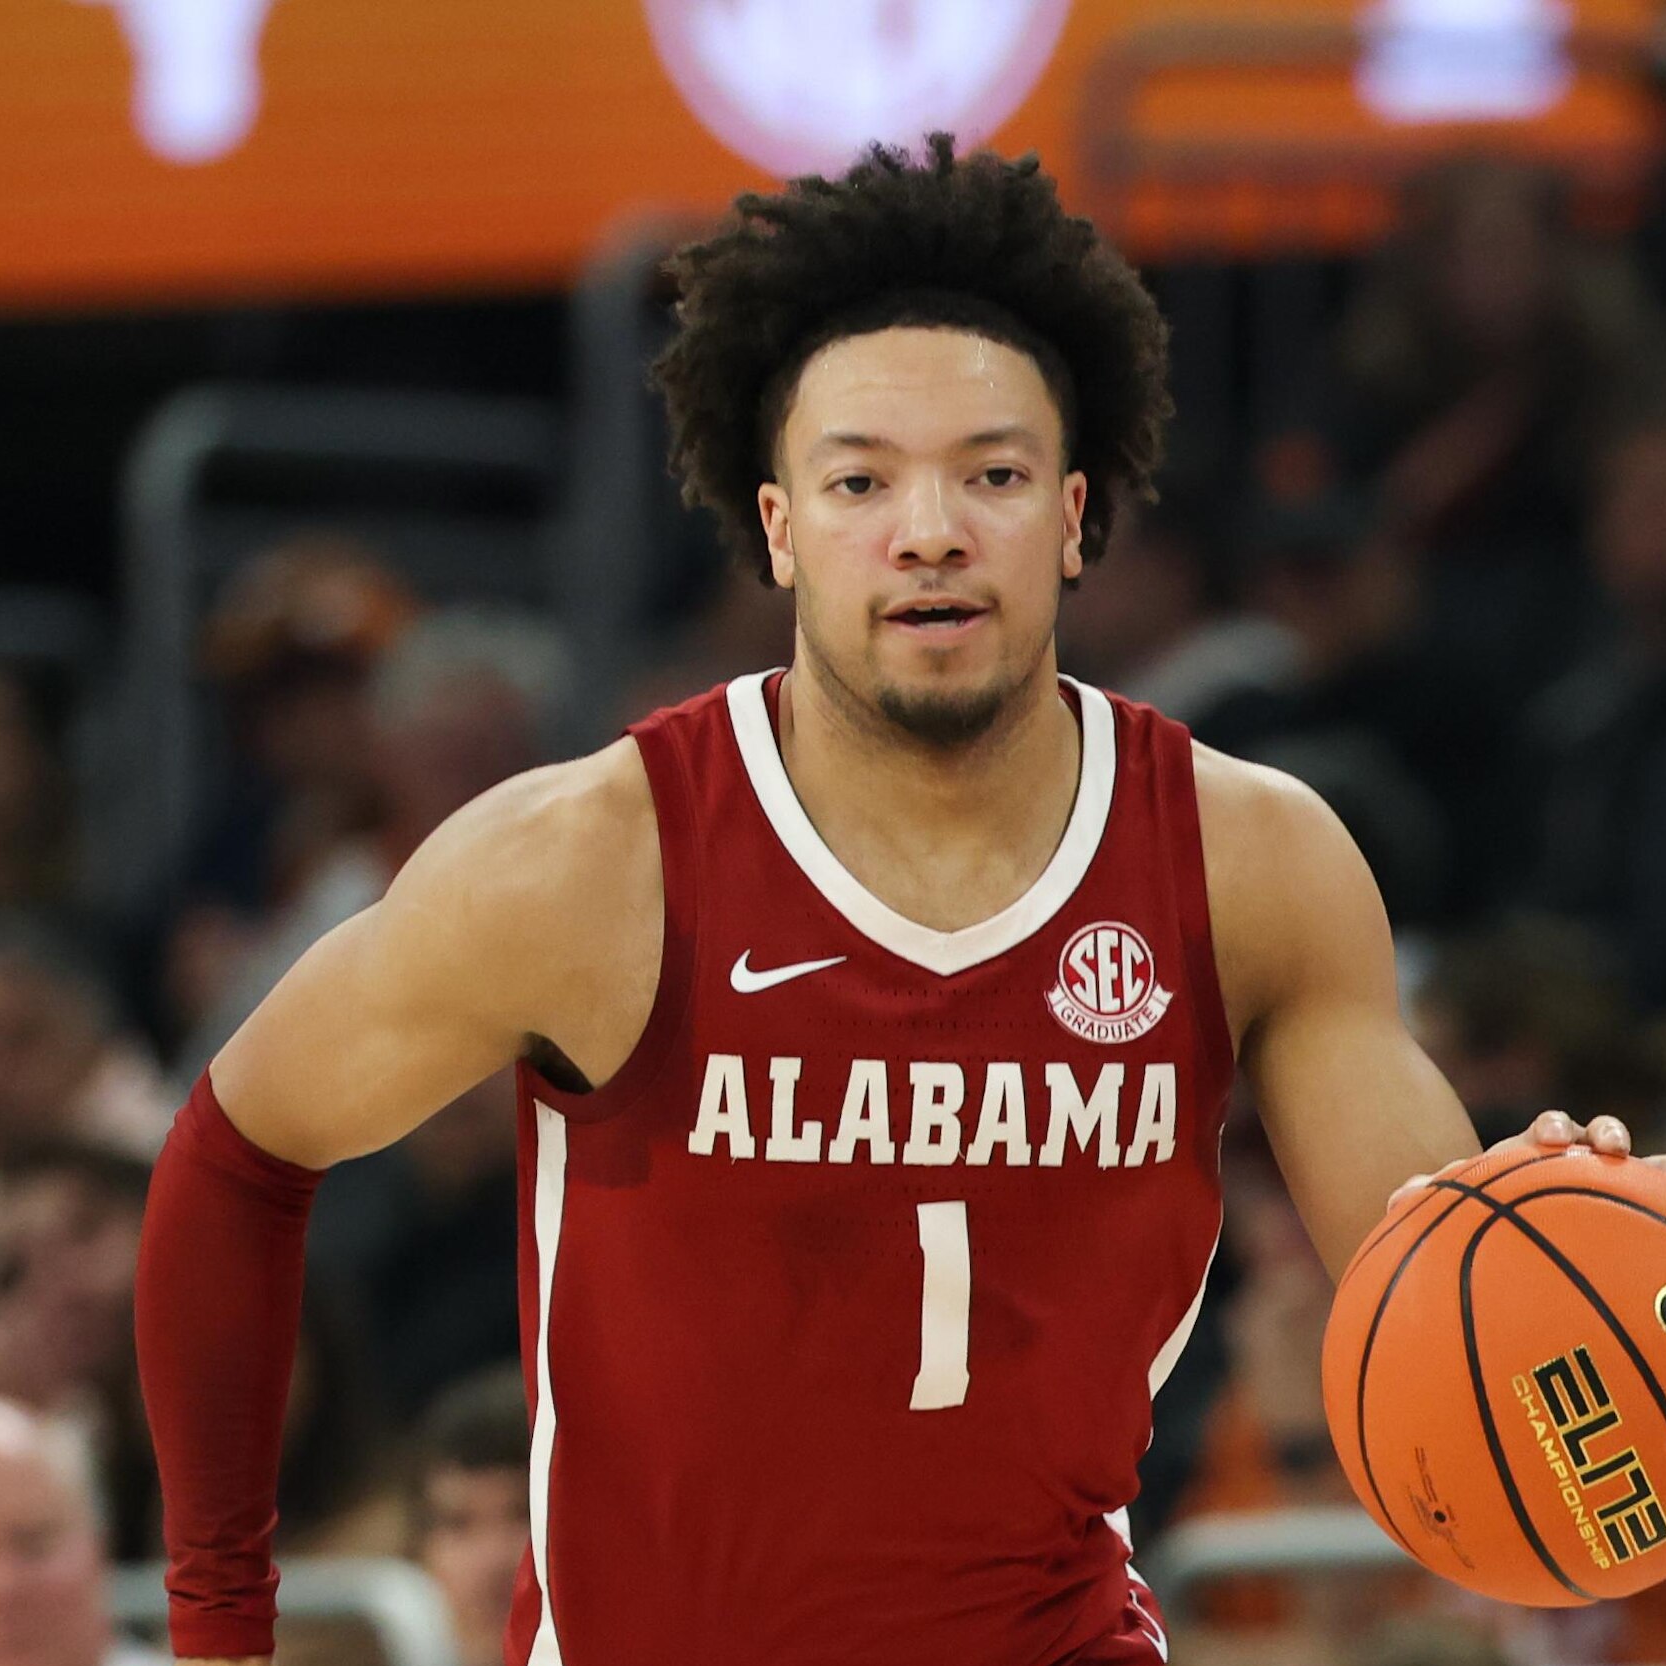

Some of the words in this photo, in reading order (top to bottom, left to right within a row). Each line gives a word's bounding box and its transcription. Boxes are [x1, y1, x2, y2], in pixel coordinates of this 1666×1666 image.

[1061, 1006, 1158, 1040] GRADUATE
[1068, 929, 1145, 1013] SEC
[687, 1053, 1177, 1169] ALABAMA
[908, 1200, 971, 1411] 1
[1511, 1374, 1611, 1571] CHAMPIONSHIP
